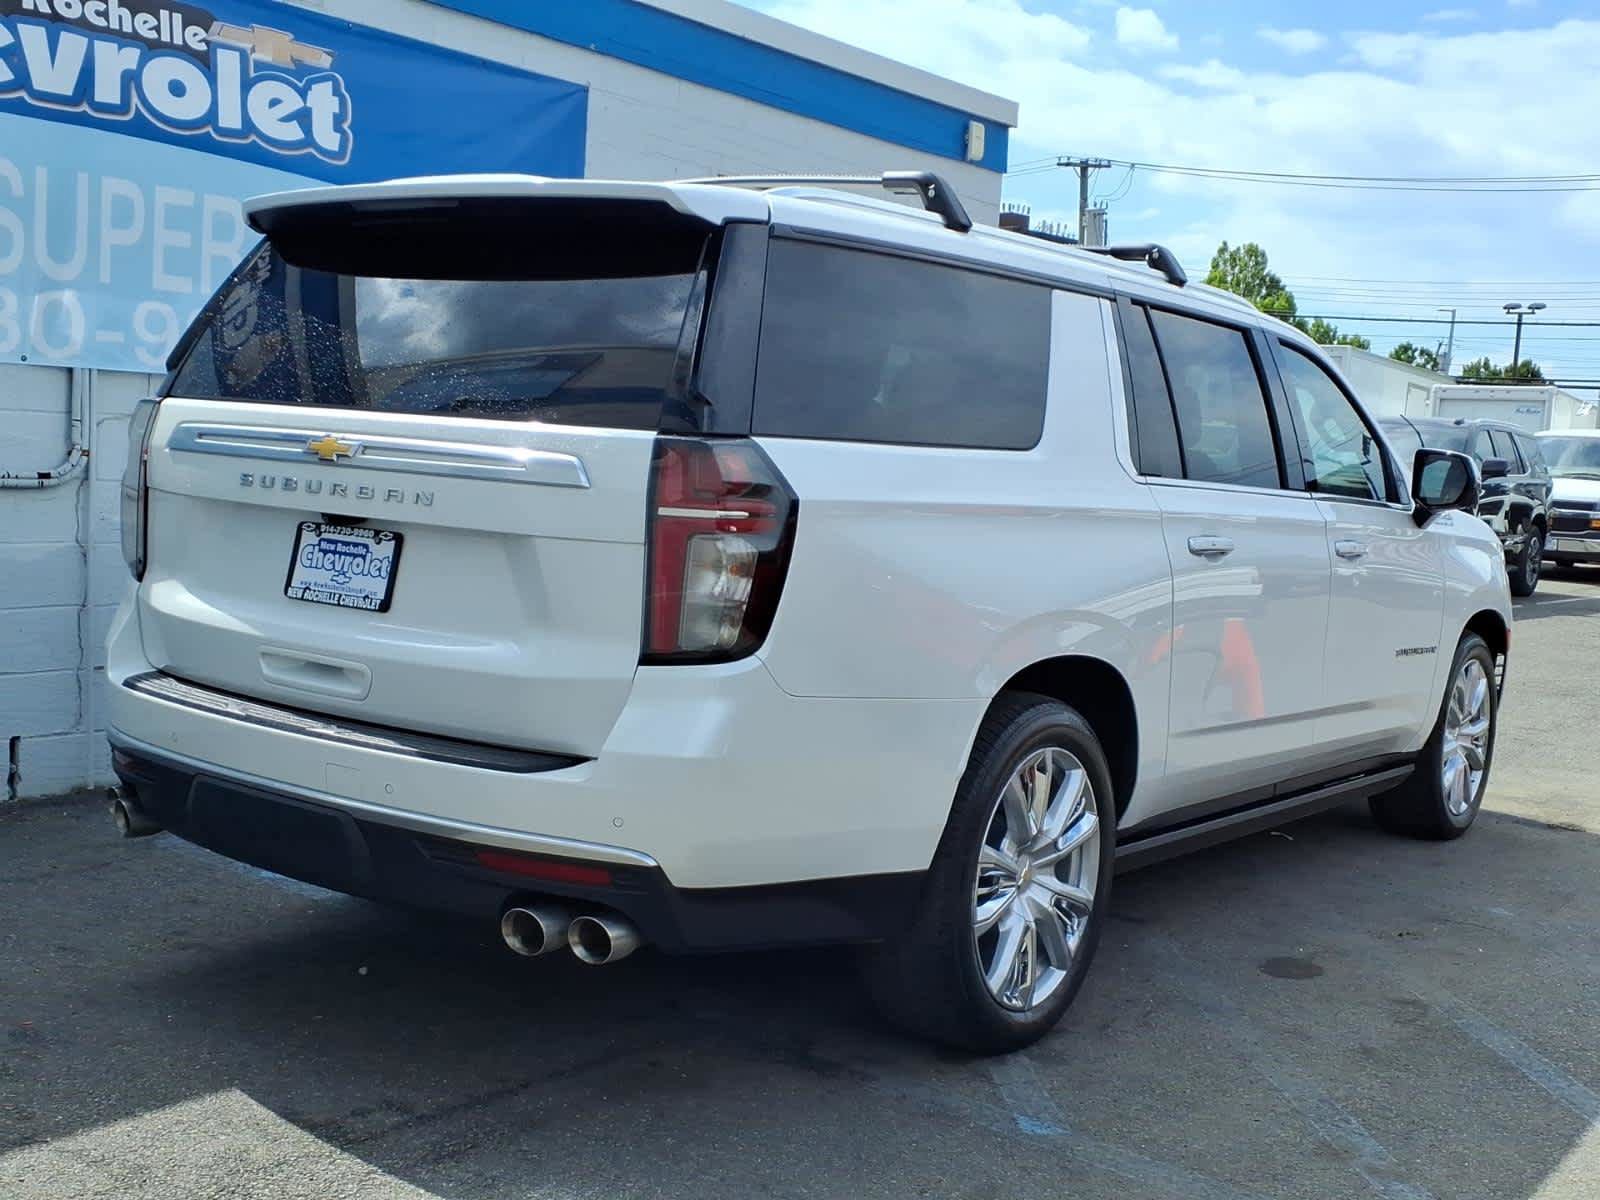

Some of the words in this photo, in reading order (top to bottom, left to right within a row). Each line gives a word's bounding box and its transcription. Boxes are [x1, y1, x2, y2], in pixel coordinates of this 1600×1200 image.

[0, 22, 342, 152] vrolet
[239, 472, 435, 506] SUBURBAN
[301, 543, 391, 580] Chevrolet
[320, 541, 336, 551] New
[336, 543, 368, 556] Rochelle
[287, 586, 302, 600] NEW
[303, 589, 339, 605] ROCHELLE
[340, 593, 381, 611] CHEVROLET
